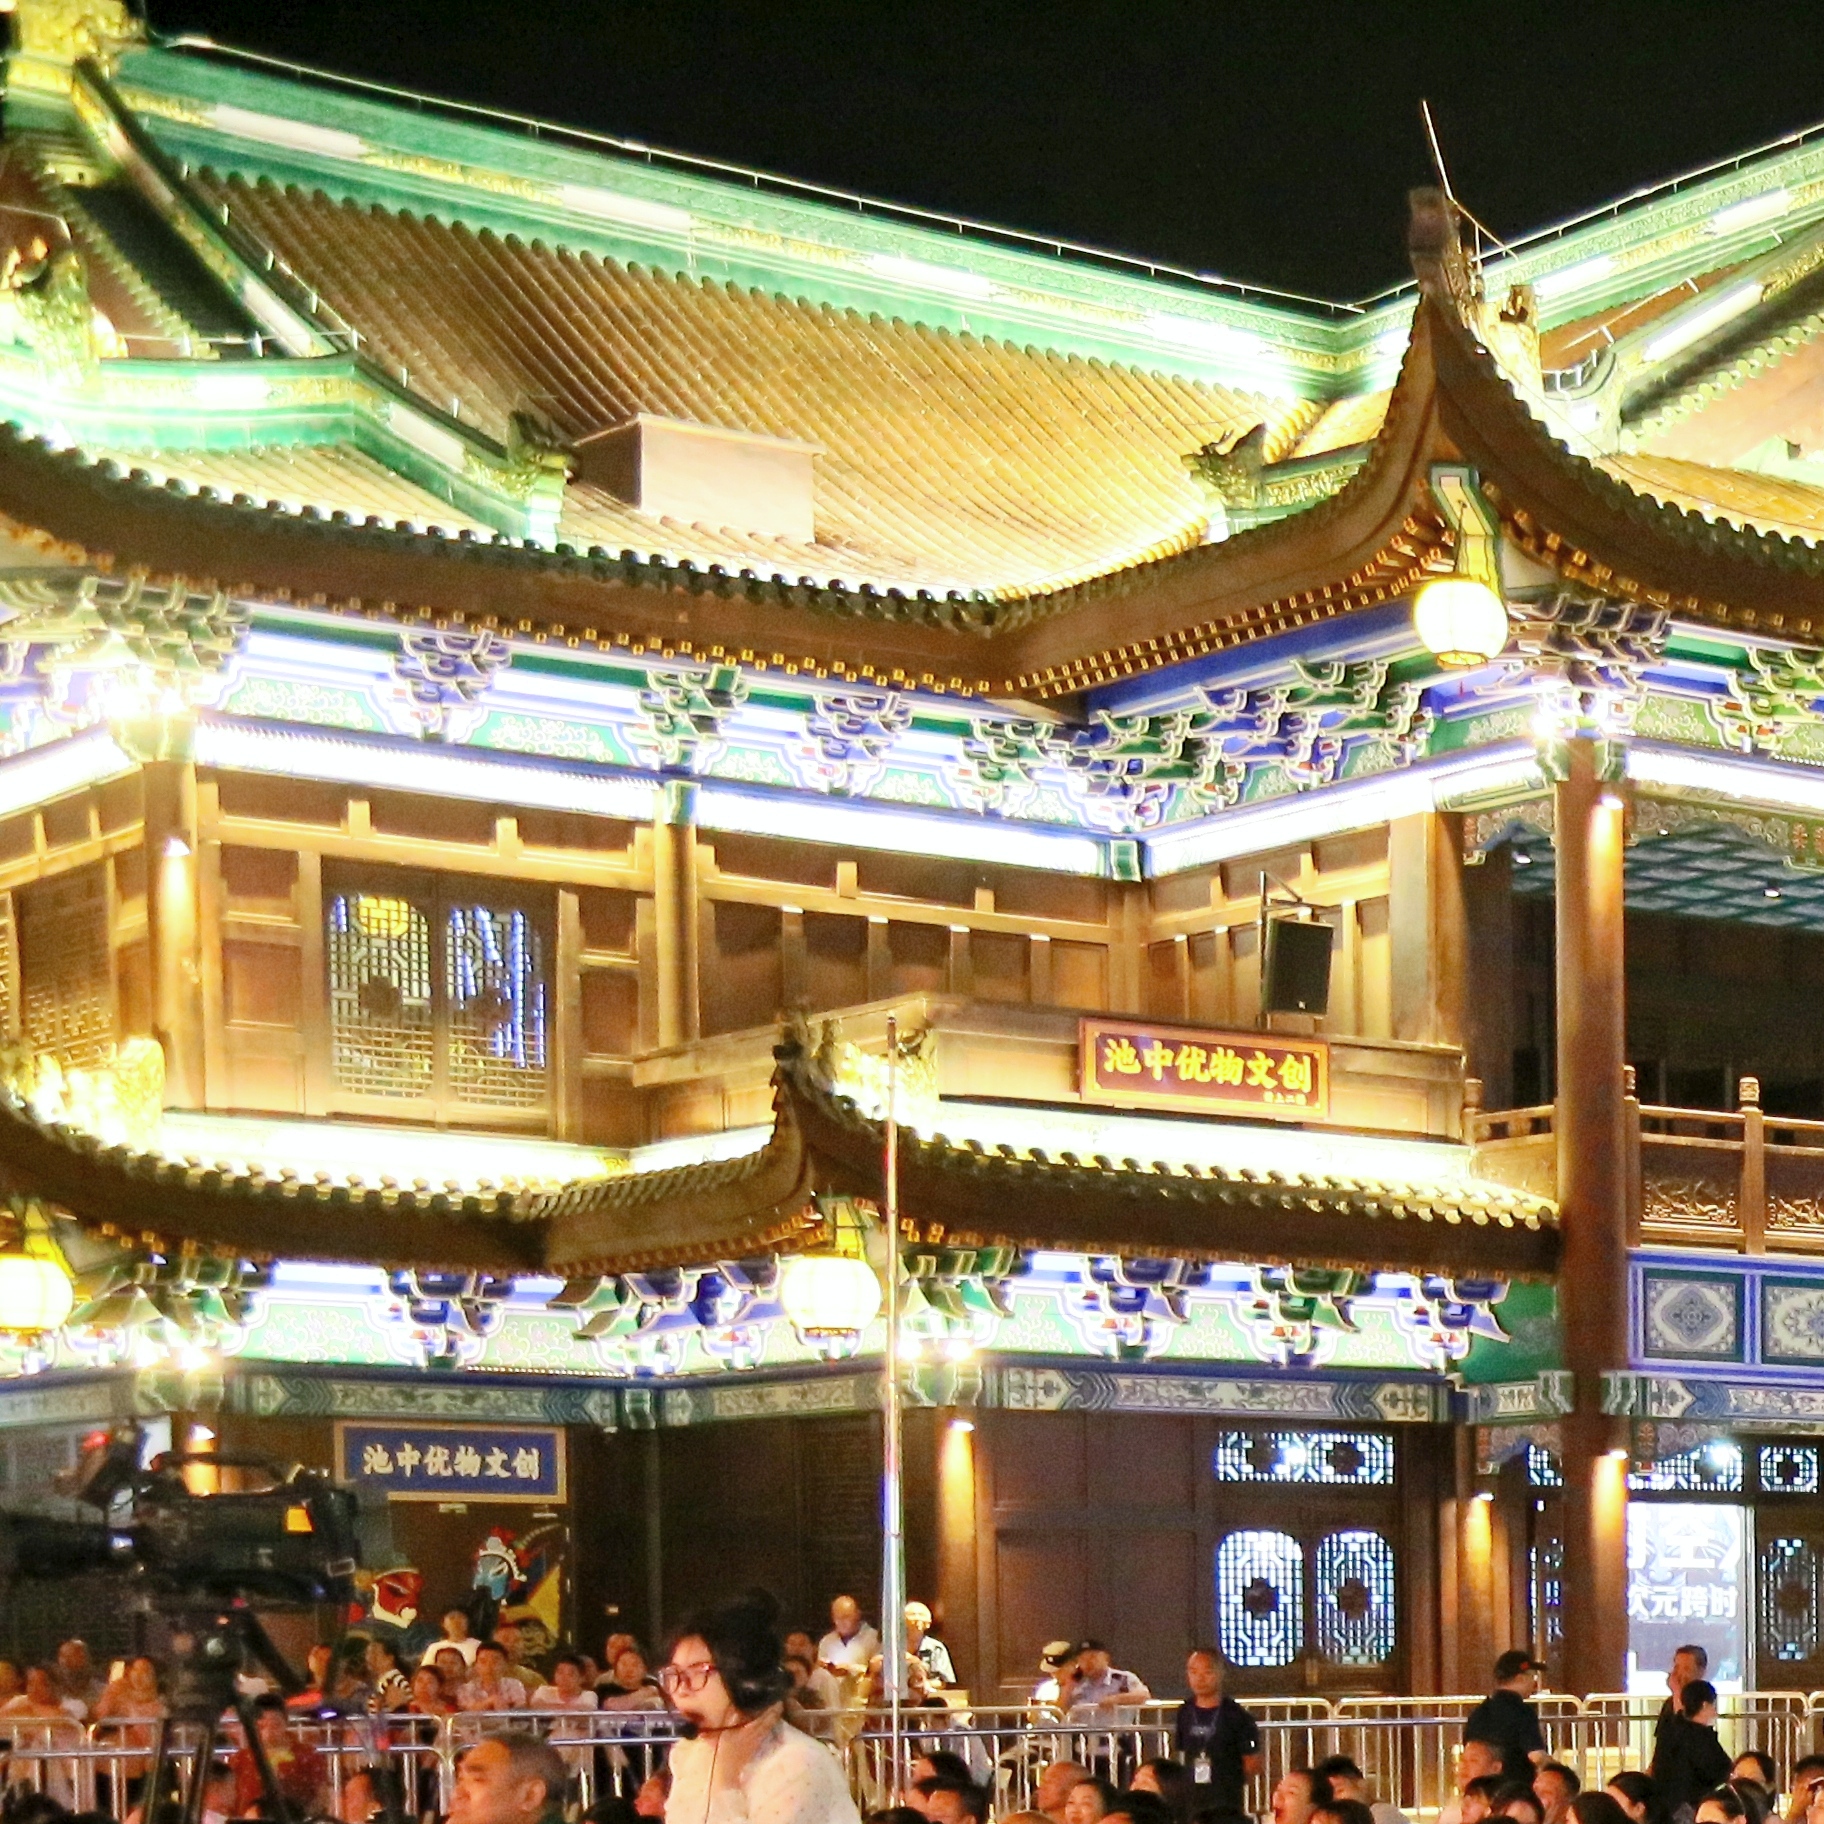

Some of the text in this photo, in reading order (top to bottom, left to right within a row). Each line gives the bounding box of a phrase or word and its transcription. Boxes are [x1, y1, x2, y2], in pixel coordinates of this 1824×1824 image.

[1104, 1038, 1312, 1093] 池中优物文创
[363, 1442, 541, 1480] 池中优物文创
